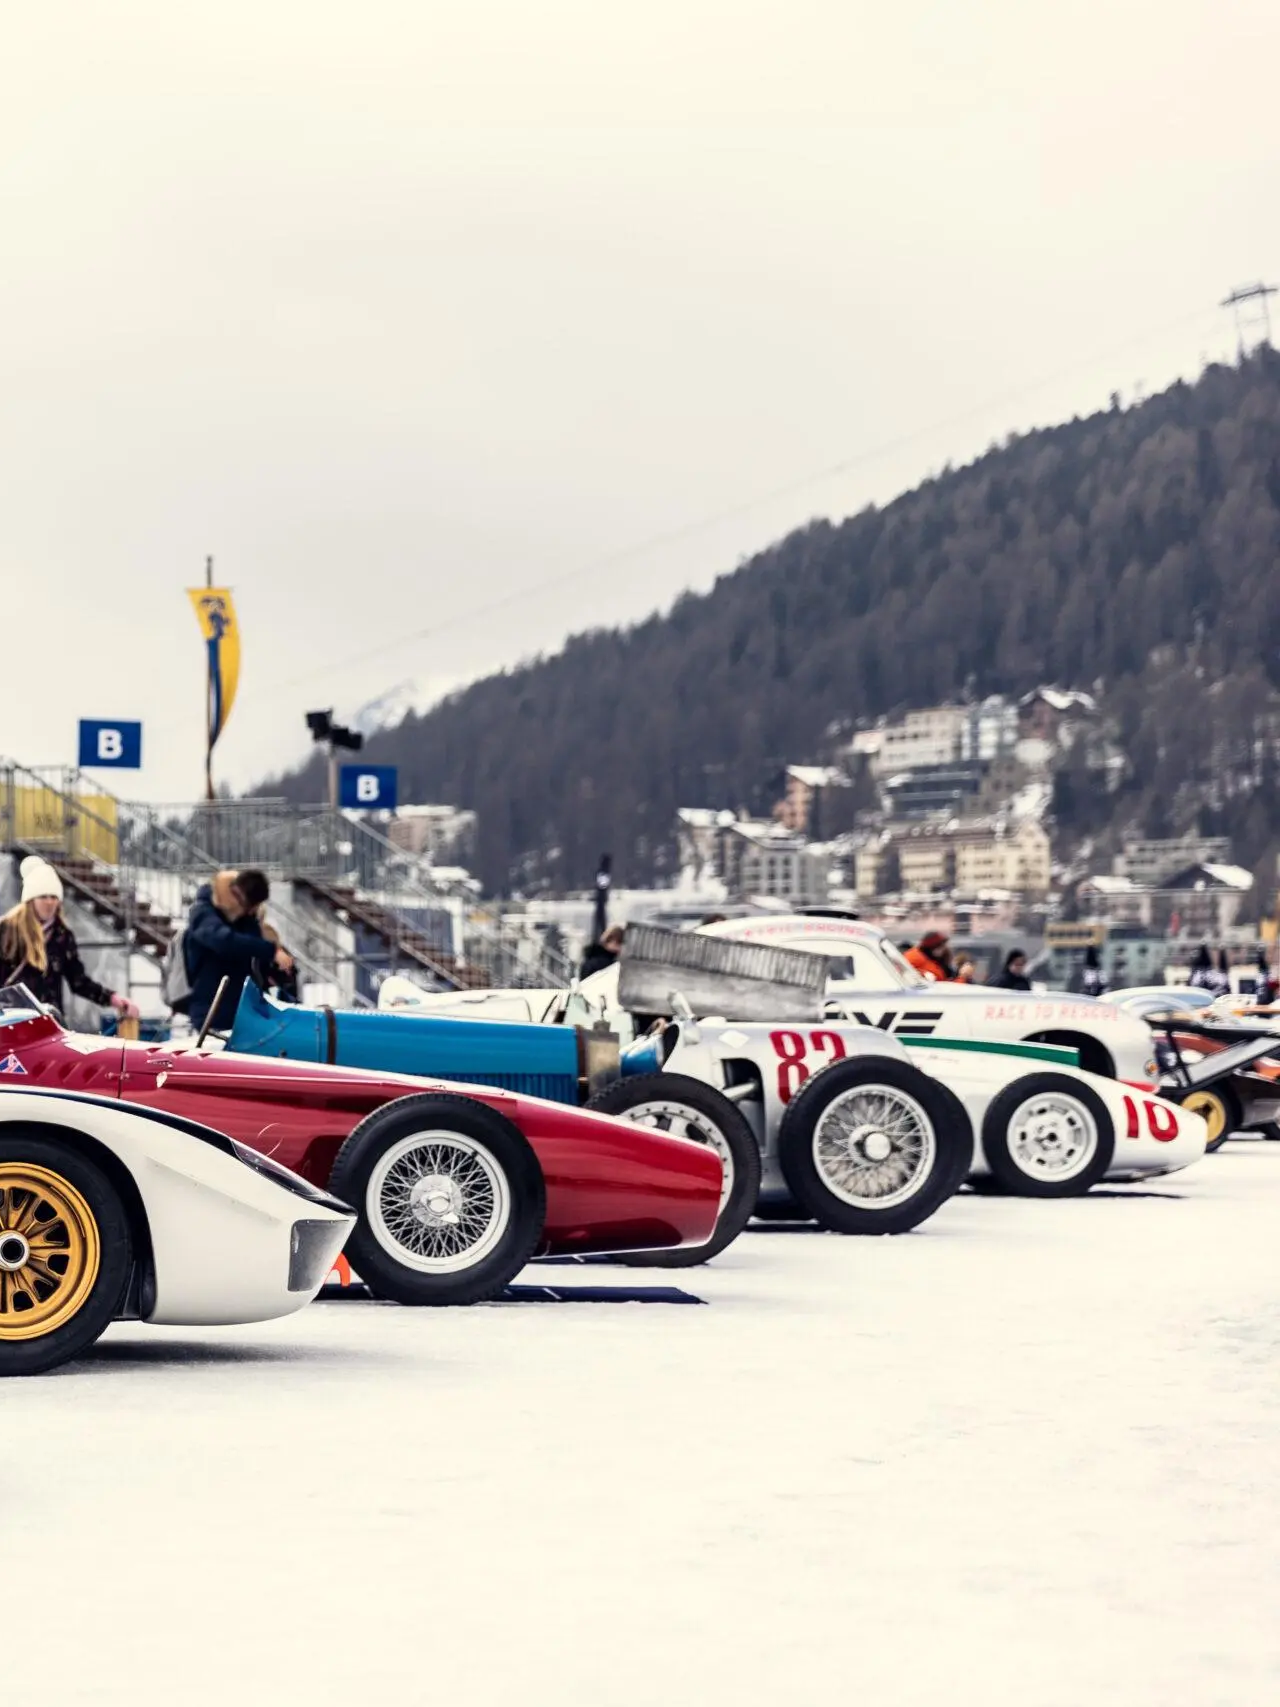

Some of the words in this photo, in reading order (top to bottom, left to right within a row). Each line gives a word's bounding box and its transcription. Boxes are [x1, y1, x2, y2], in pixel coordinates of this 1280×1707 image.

[97, 728, 123, 759] B
[356, 774, 379, 801] B
[985, 1004, 1026, 1020] RACE
[1035, 1003, 1054, 1020] TO
[1059, 1003, 1118, 1021] RESCUE
[1122, 1095, 1179, 1142] 10
